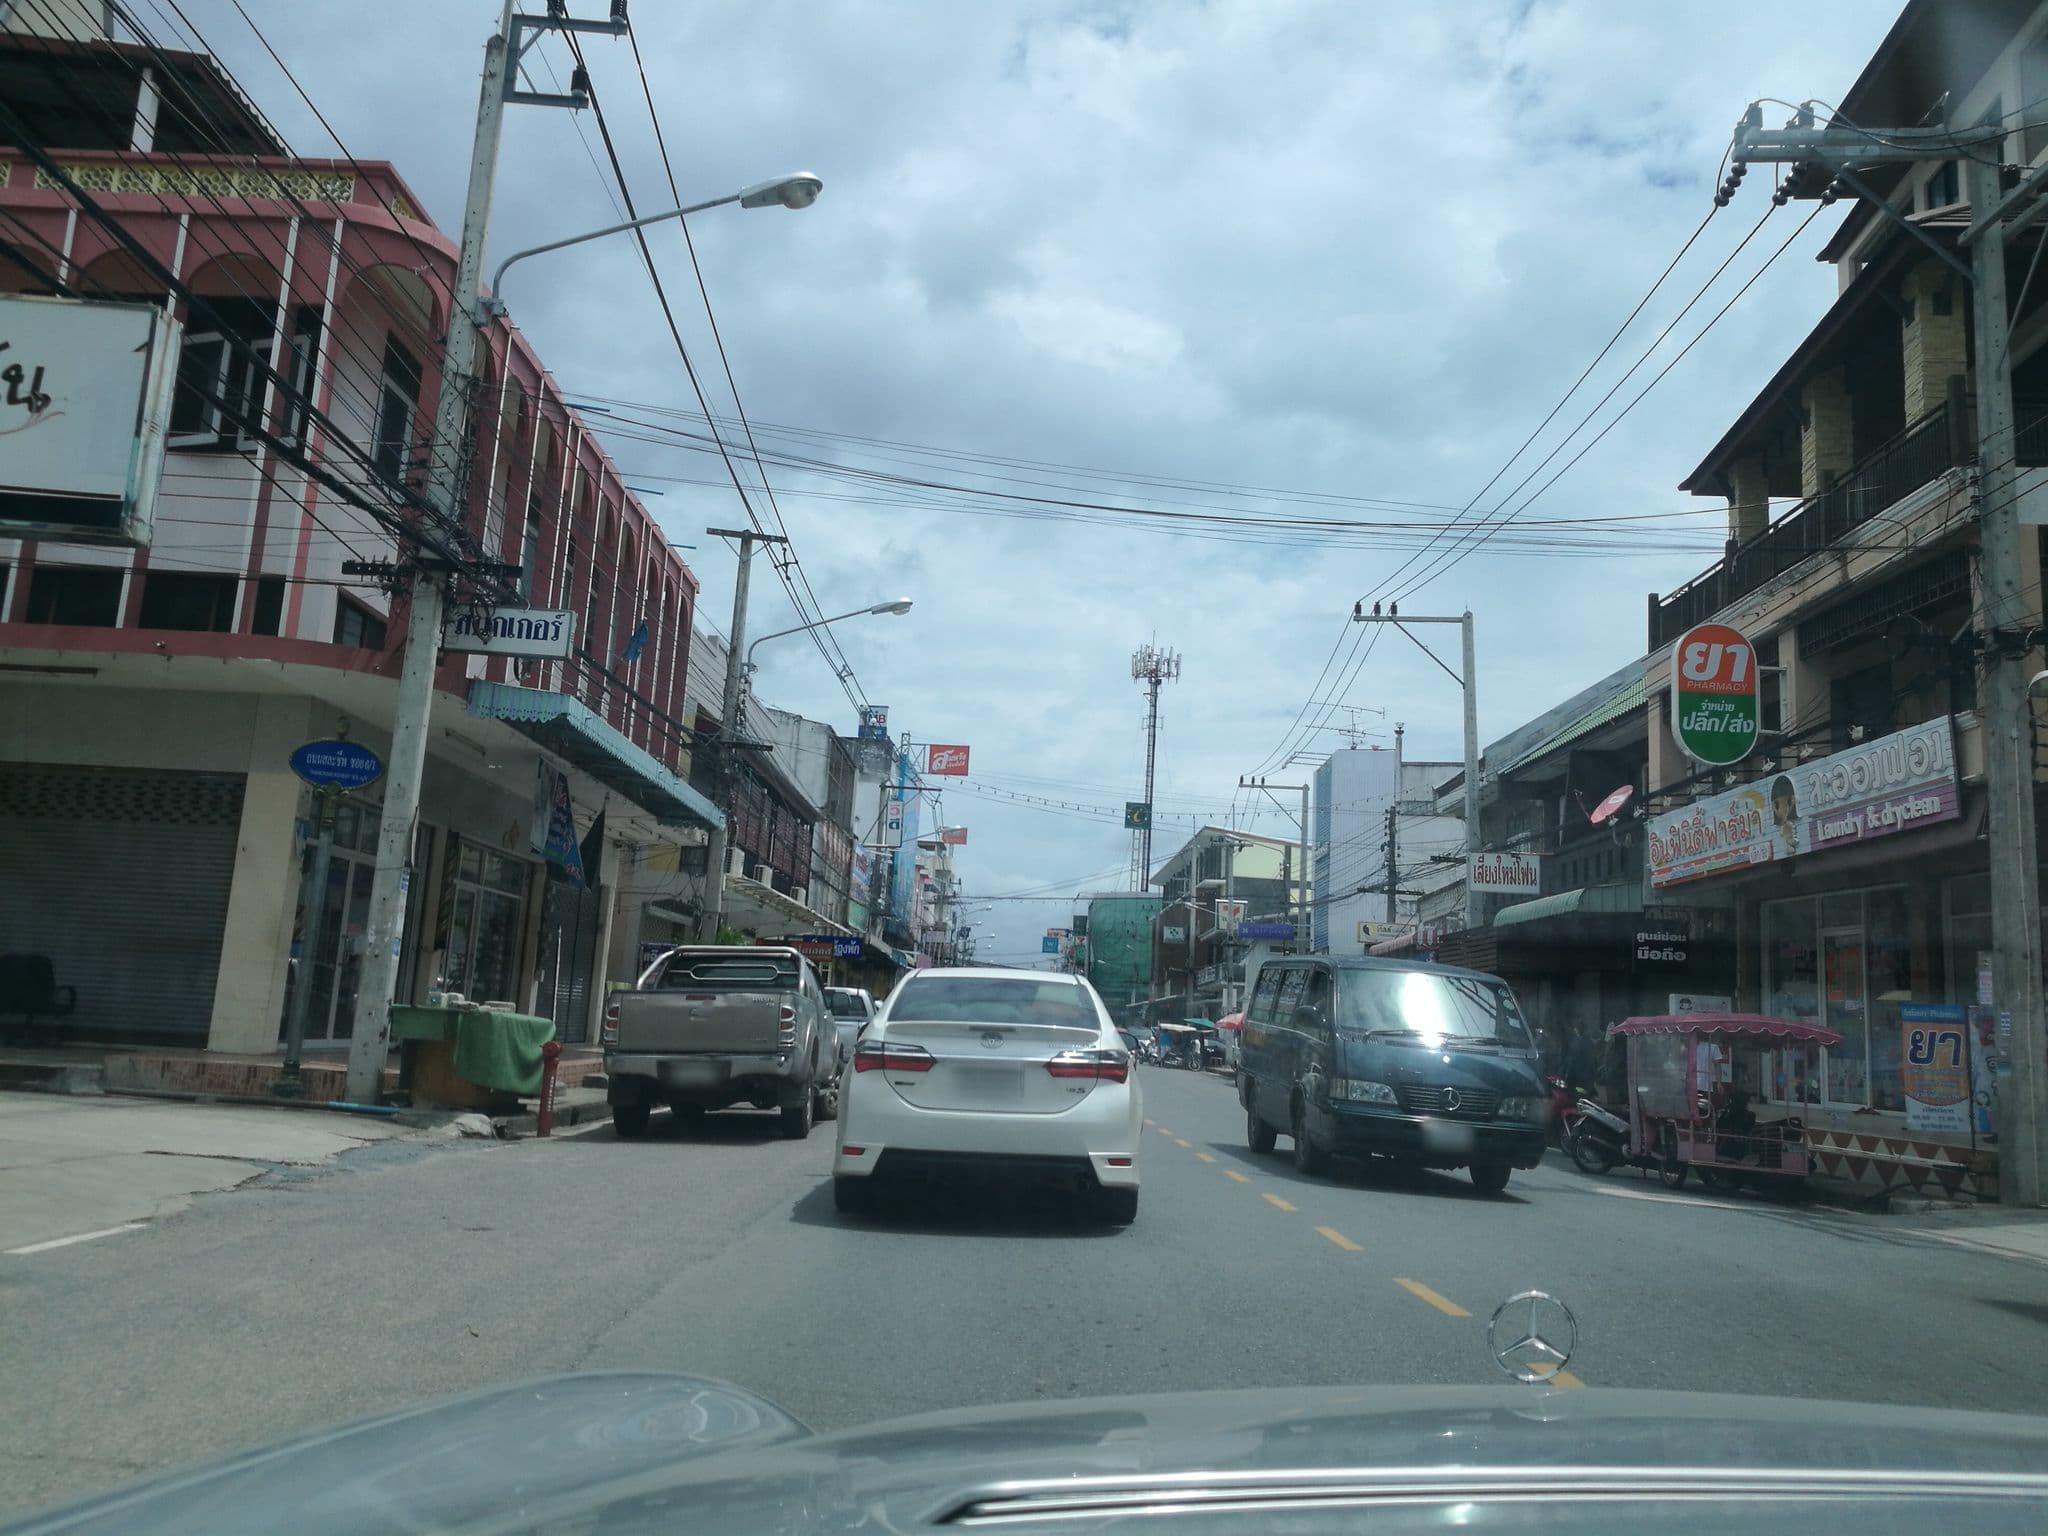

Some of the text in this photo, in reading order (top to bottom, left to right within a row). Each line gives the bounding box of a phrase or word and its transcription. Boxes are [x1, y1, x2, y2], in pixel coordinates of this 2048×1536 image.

[1682, 642, 1751, 682] ยา
[1686, 680, 1749, 691] PHARMACY
[1700, 699, 1735, 712] จำหน่าย
[1682, 711, 1755, 733] ปลีก/ส่ง
[1817, 795, 1941, 841] Laundry & dryclean
[1637, 946, 1687, 961] มือถือ
[1908, 1029, 1963, 1070] ยา
